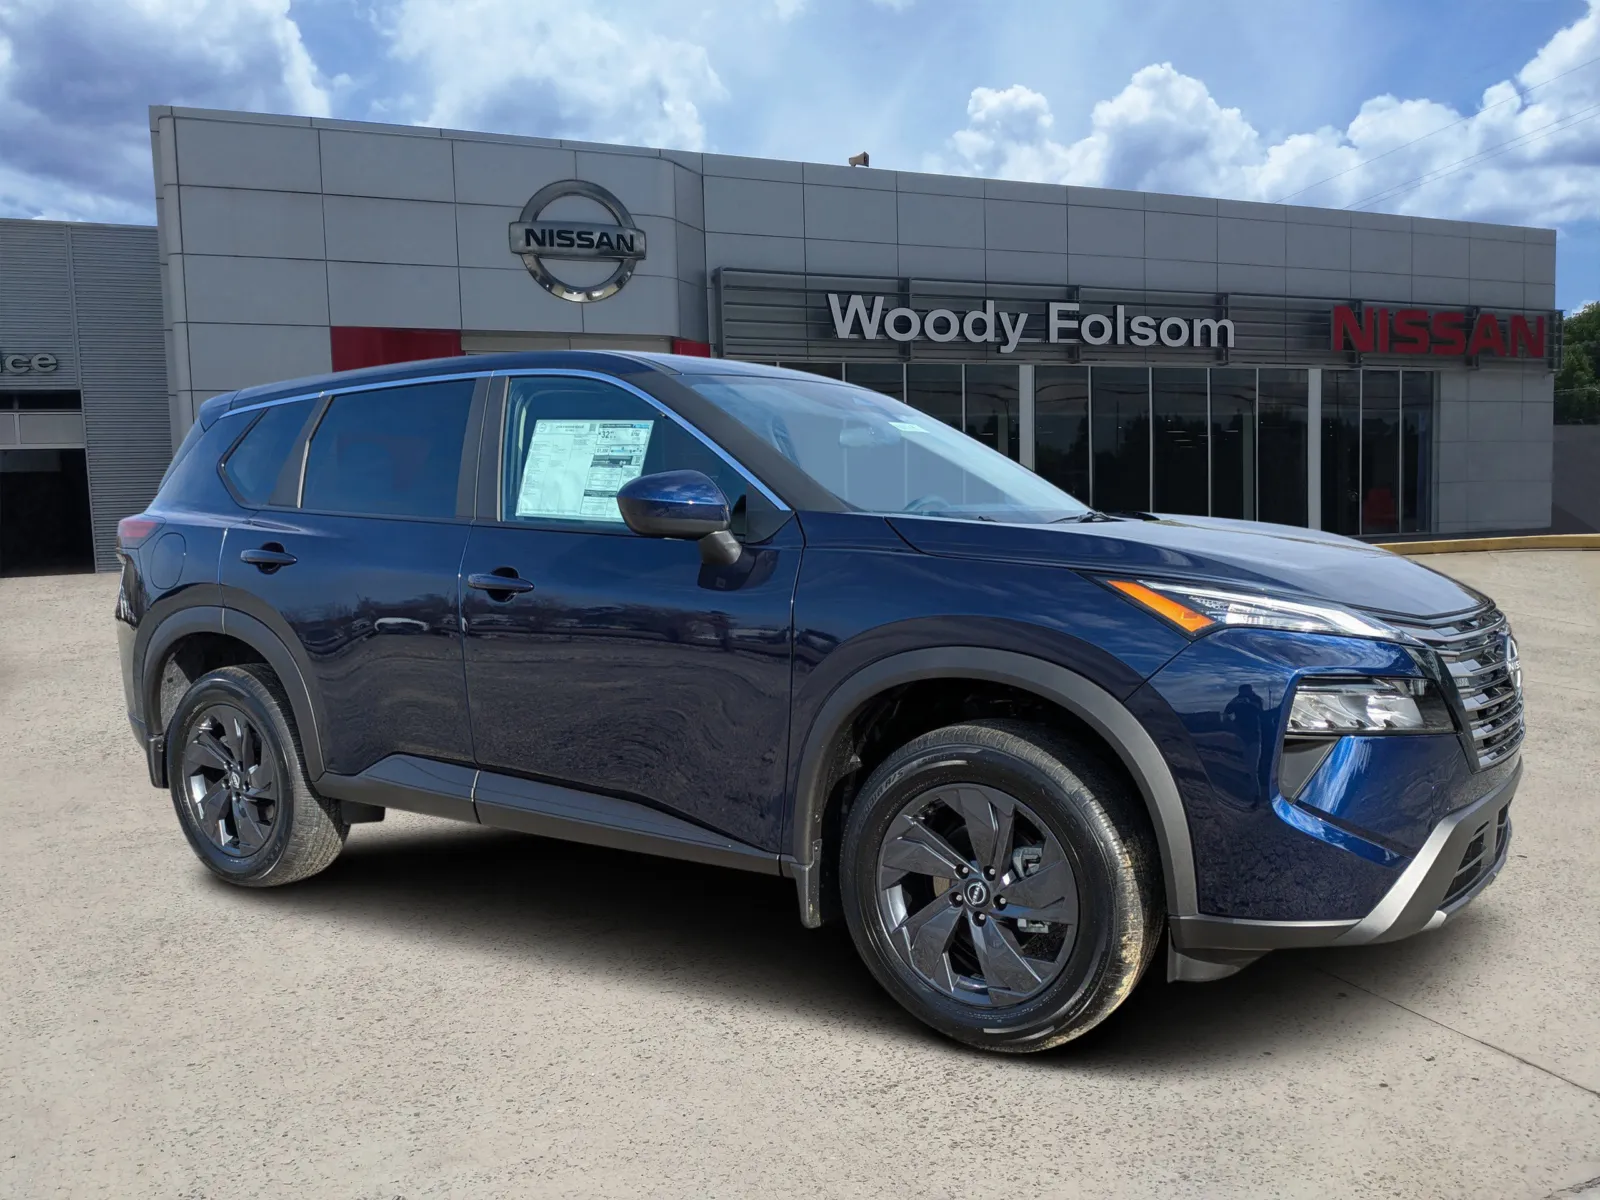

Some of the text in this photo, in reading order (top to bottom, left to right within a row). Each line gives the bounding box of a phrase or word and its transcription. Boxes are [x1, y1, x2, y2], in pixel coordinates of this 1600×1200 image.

[524, 228, 635, 252] NISSAN
[827, 293, 1236, 354] Woody Folsom
[1332, 305, 1545, 359] NISSAN
